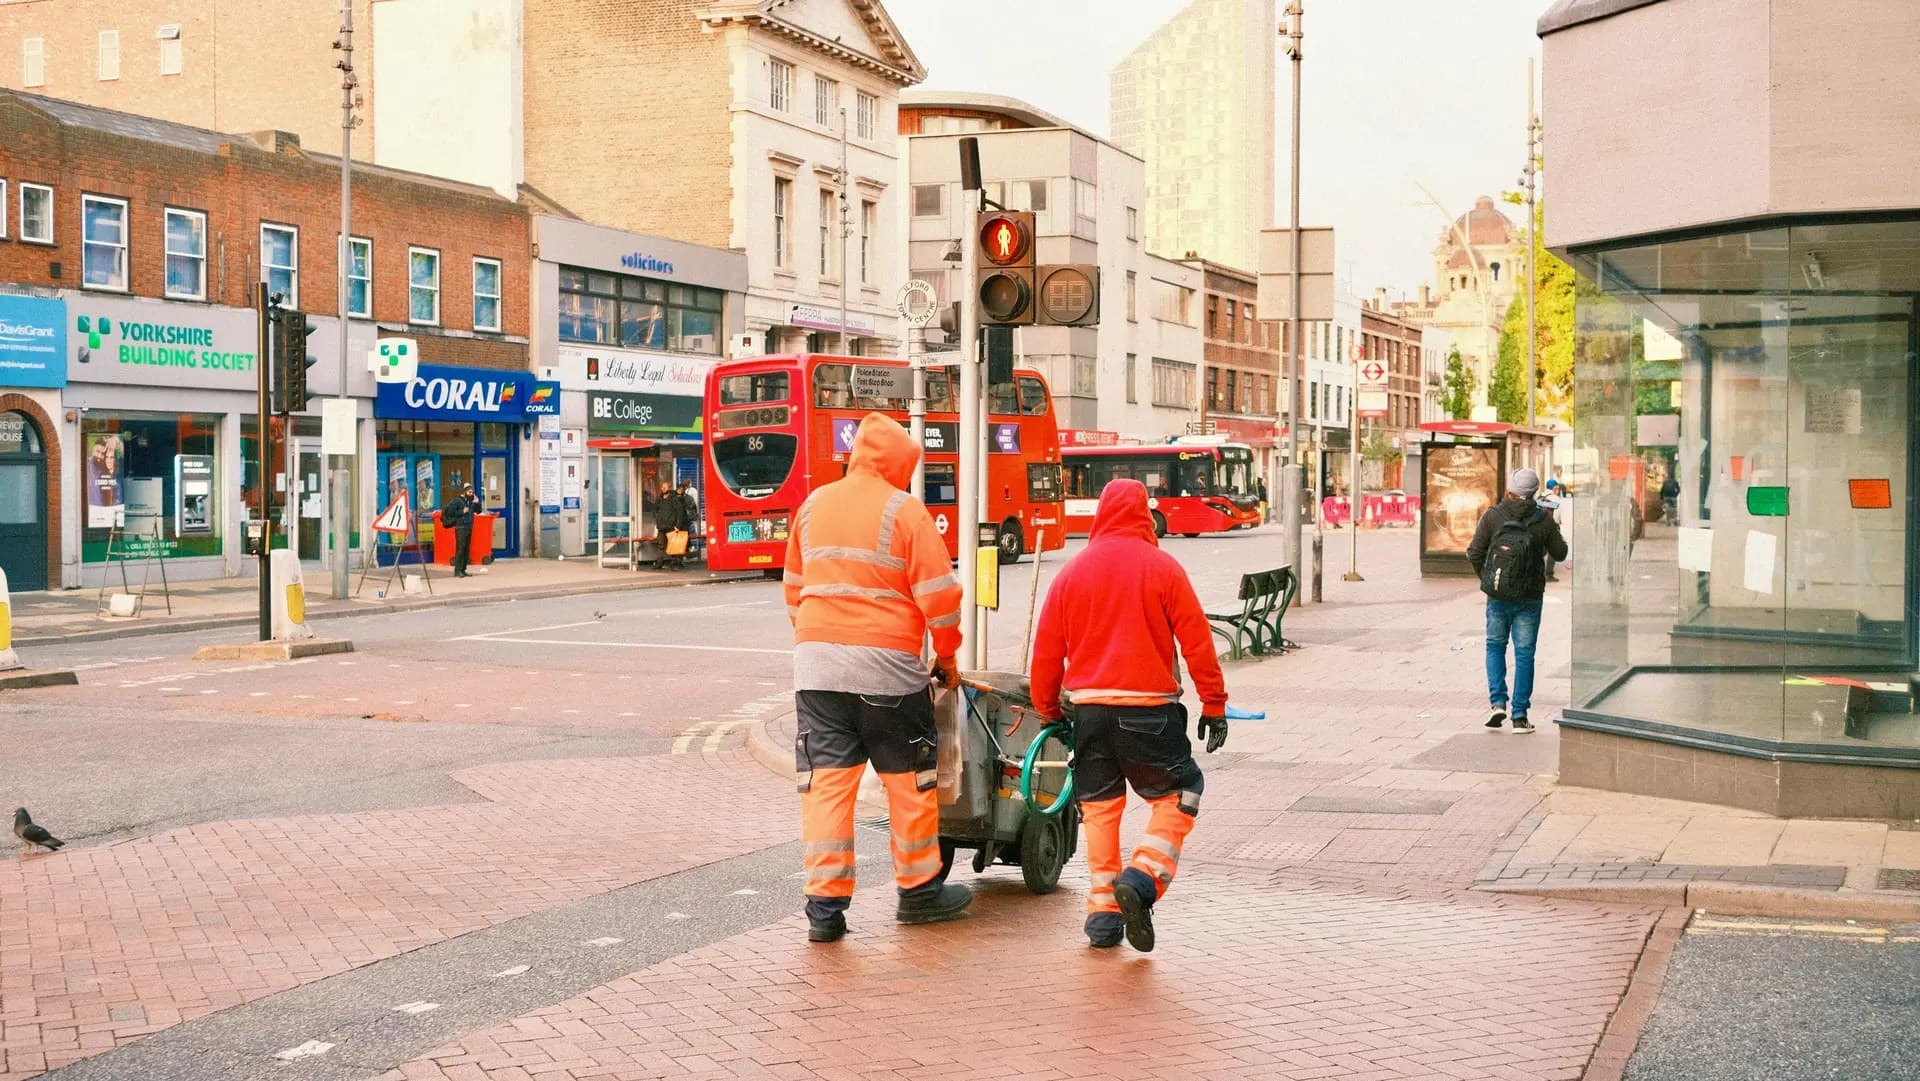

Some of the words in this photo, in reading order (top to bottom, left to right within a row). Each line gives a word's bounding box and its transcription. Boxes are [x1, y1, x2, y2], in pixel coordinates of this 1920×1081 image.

[621, 252, 674, 274] solicitors
[903, 281, 930, 293] ILFORD
[896, 302, 913, 322] TOWN
[914, 300, 936, 324] CENTRE
[119, 321, 213, 347] YORKSHIRE
[119, 345, 197, 369] BUILDING
[201, 351, 258, 371] SOCIET
[604, 357, 637, 385] Liberty
[640, 360, 666, 386] Legal
[856, 377, 868, 386] First
[872, 368, 890, 377] Station
[405, 376, 499, 412] CORAL
[526, 404, 554, 413] CORAL
[593, 397, 612, 419] BE
[613, 399, 653, 425] College
[748, 436, 764, 451] 86
